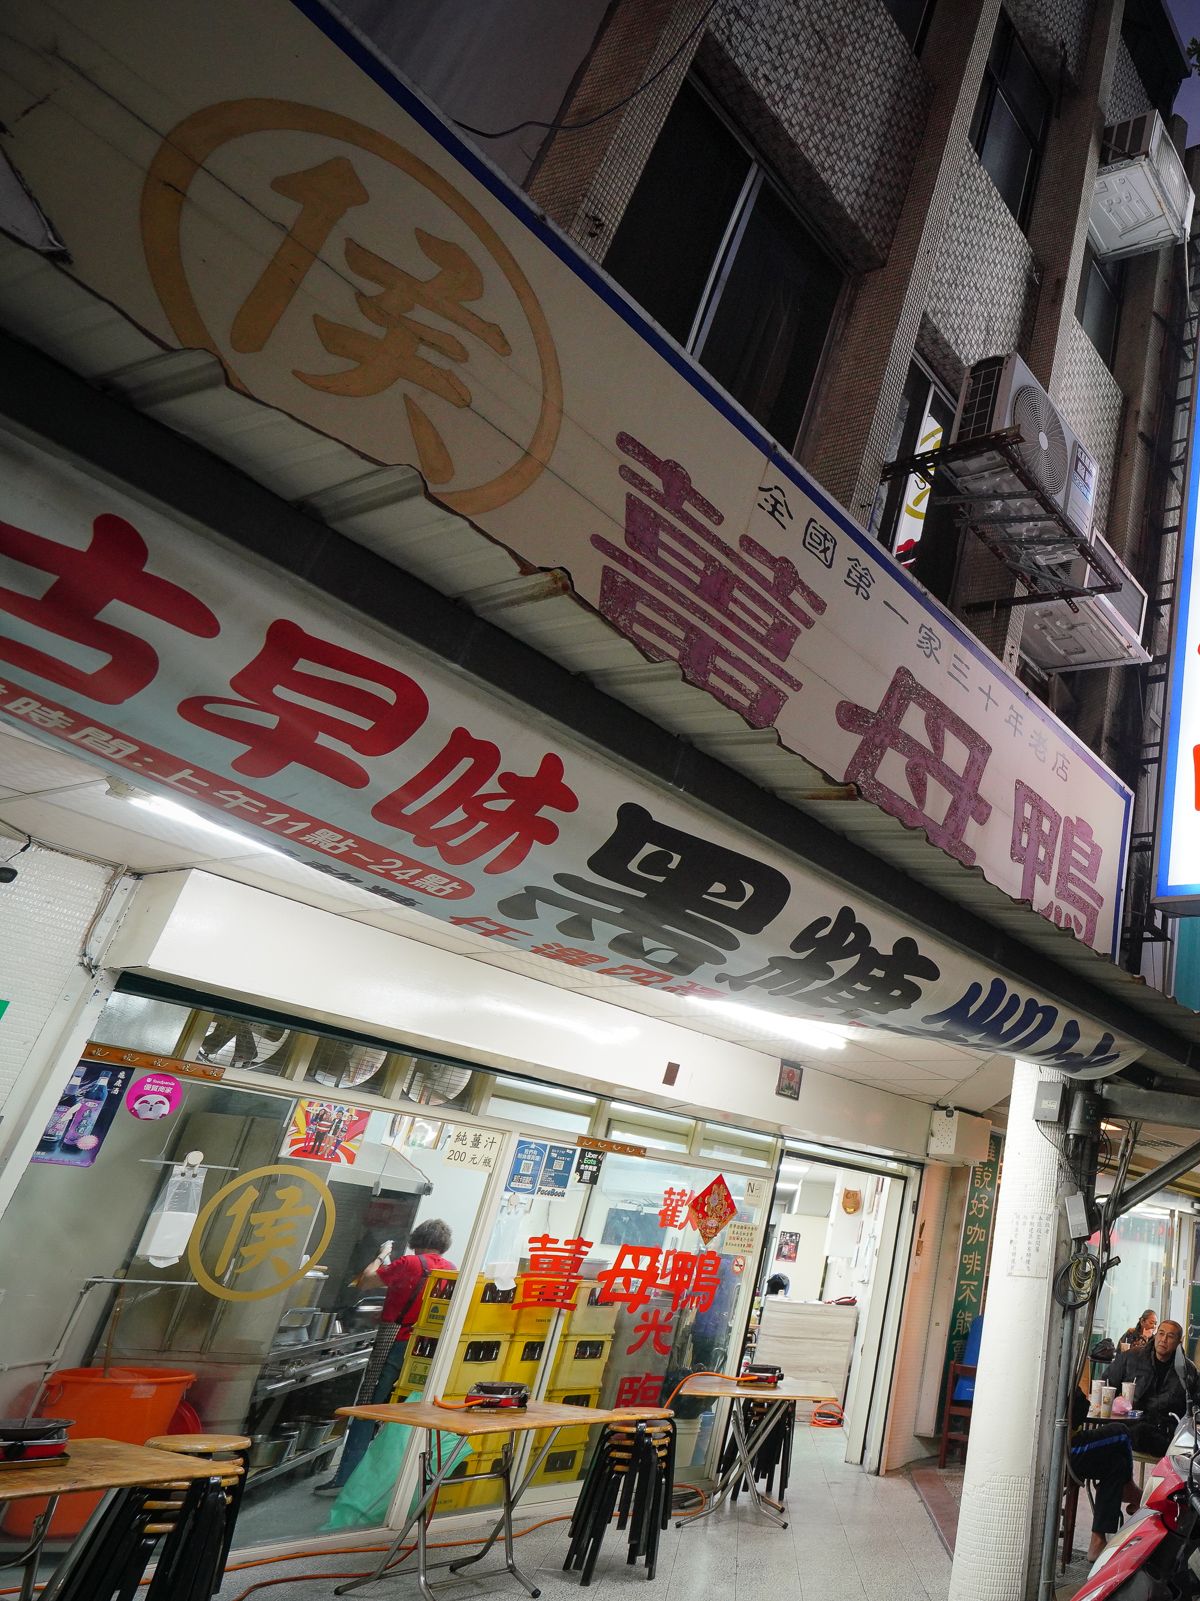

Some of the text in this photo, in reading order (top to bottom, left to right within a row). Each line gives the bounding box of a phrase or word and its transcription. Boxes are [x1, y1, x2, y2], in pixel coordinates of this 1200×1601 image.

[756, 483, 1071, 783] 全國第一家三十年老店
[589, 431, 1105, 948] 薑母鴨
[453, 1131, 497, 1151] 純薑汁
[585, 1151, 598, 1159] Uber
[536, 1186, 566, 1198] FaceBook
[511, 1234, 722, 1314] 薑母鴨
